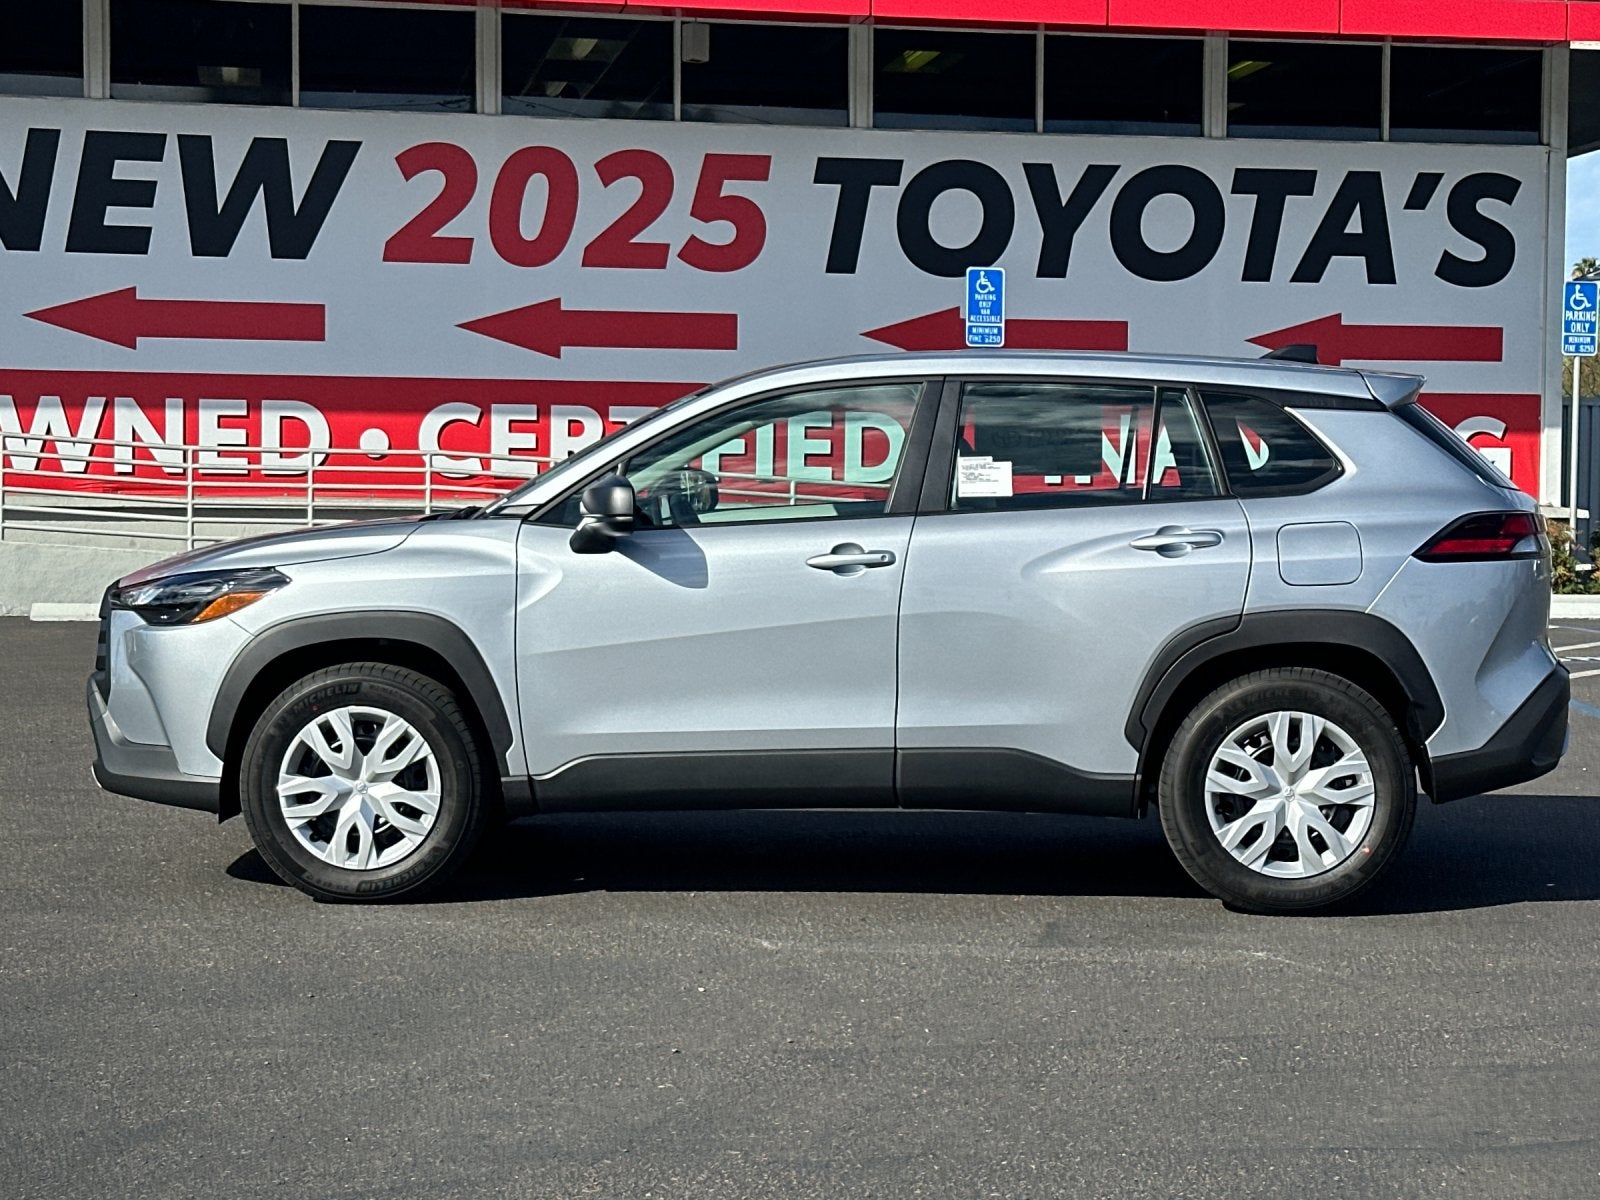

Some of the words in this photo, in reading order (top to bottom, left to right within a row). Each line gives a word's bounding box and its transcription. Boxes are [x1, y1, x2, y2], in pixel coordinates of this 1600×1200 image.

[382, 142, 772, 272] 2025
[812, 157, 1523, 287] TOYOTA'S
[974, 293, 997, 301] PARKING
[1565, 310, 1596, 322] PARKING
[1571, 322, 1590, 333] ONLY
[1568, 336, 1591, 344] MINIMUM
[418, 402, 906, 483] CERIED
[295, 684, 360, 711] MICHELIN
